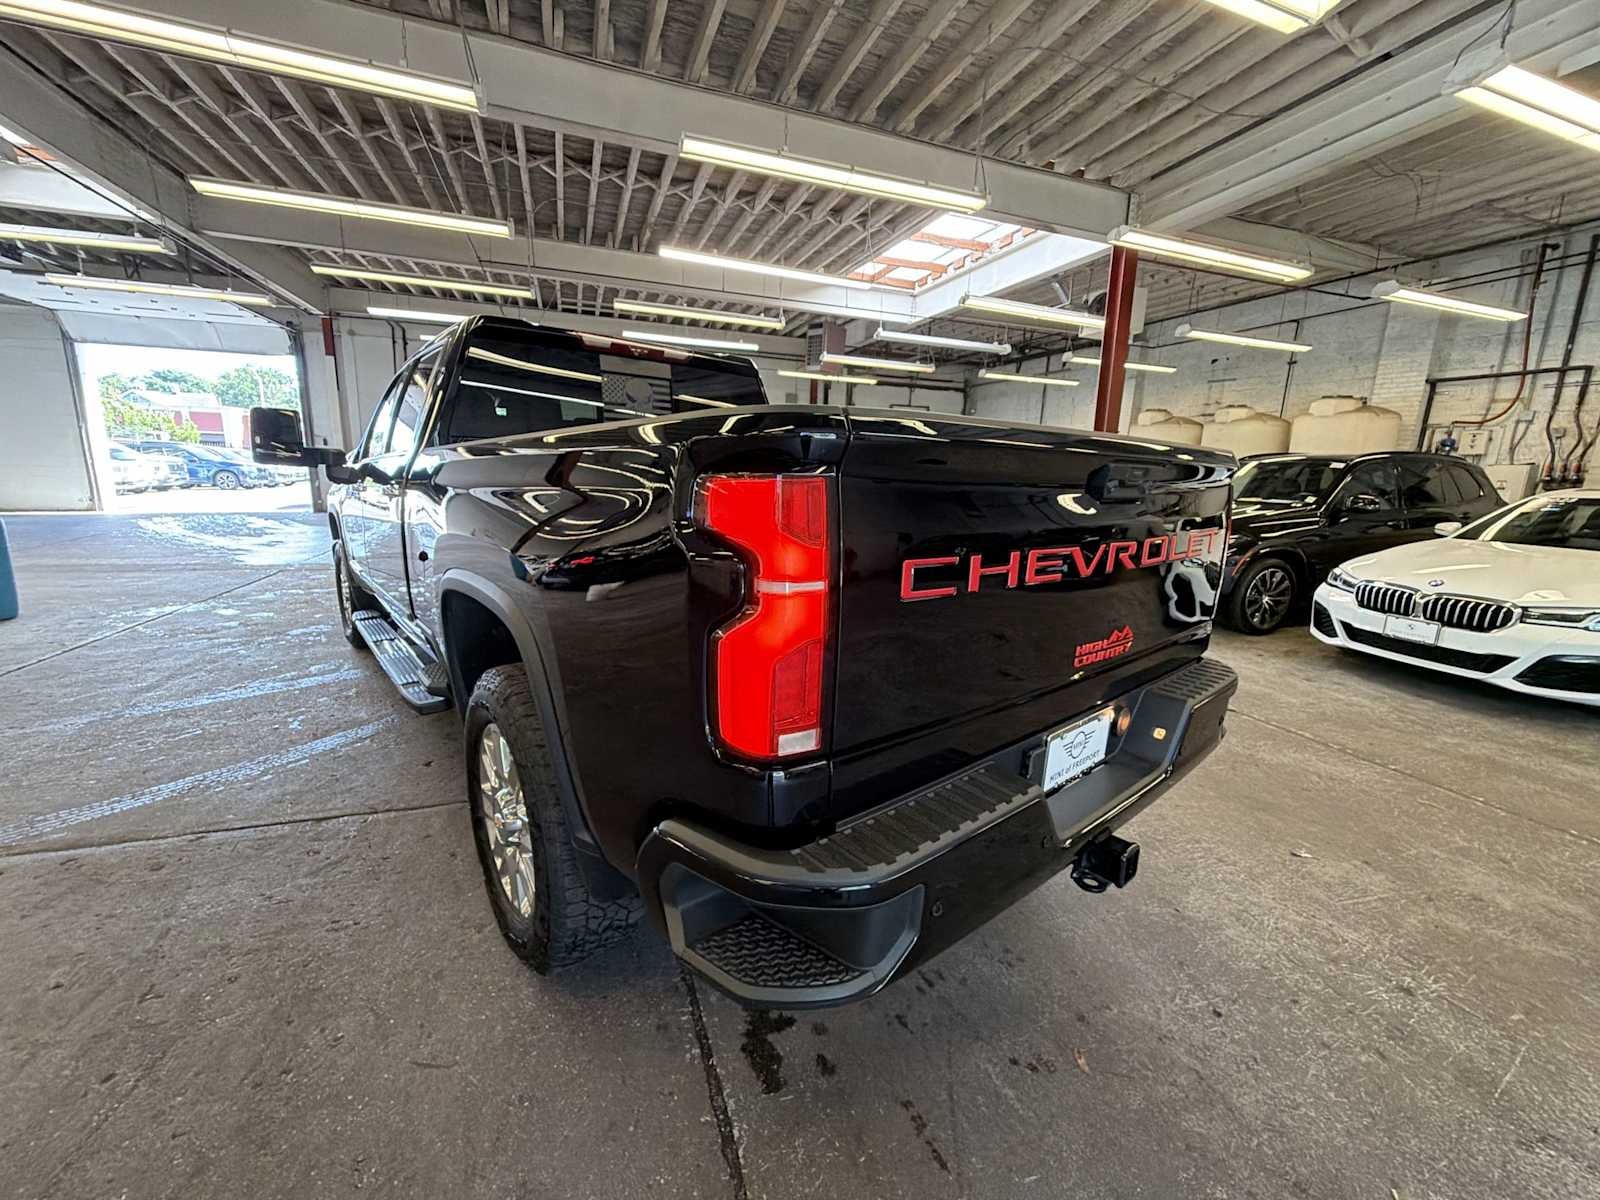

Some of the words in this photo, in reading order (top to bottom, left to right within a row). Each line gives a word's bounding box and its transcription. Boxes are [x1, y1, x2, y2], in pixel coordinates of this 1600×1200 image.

[901, 531, 1217, 601] CHEVROLET
[1073, 641, 1133, 668] COUNTRY
[1075, 639, 1109, 657] HIGH
[1071, 749, 1101, 771] FREEPORT
